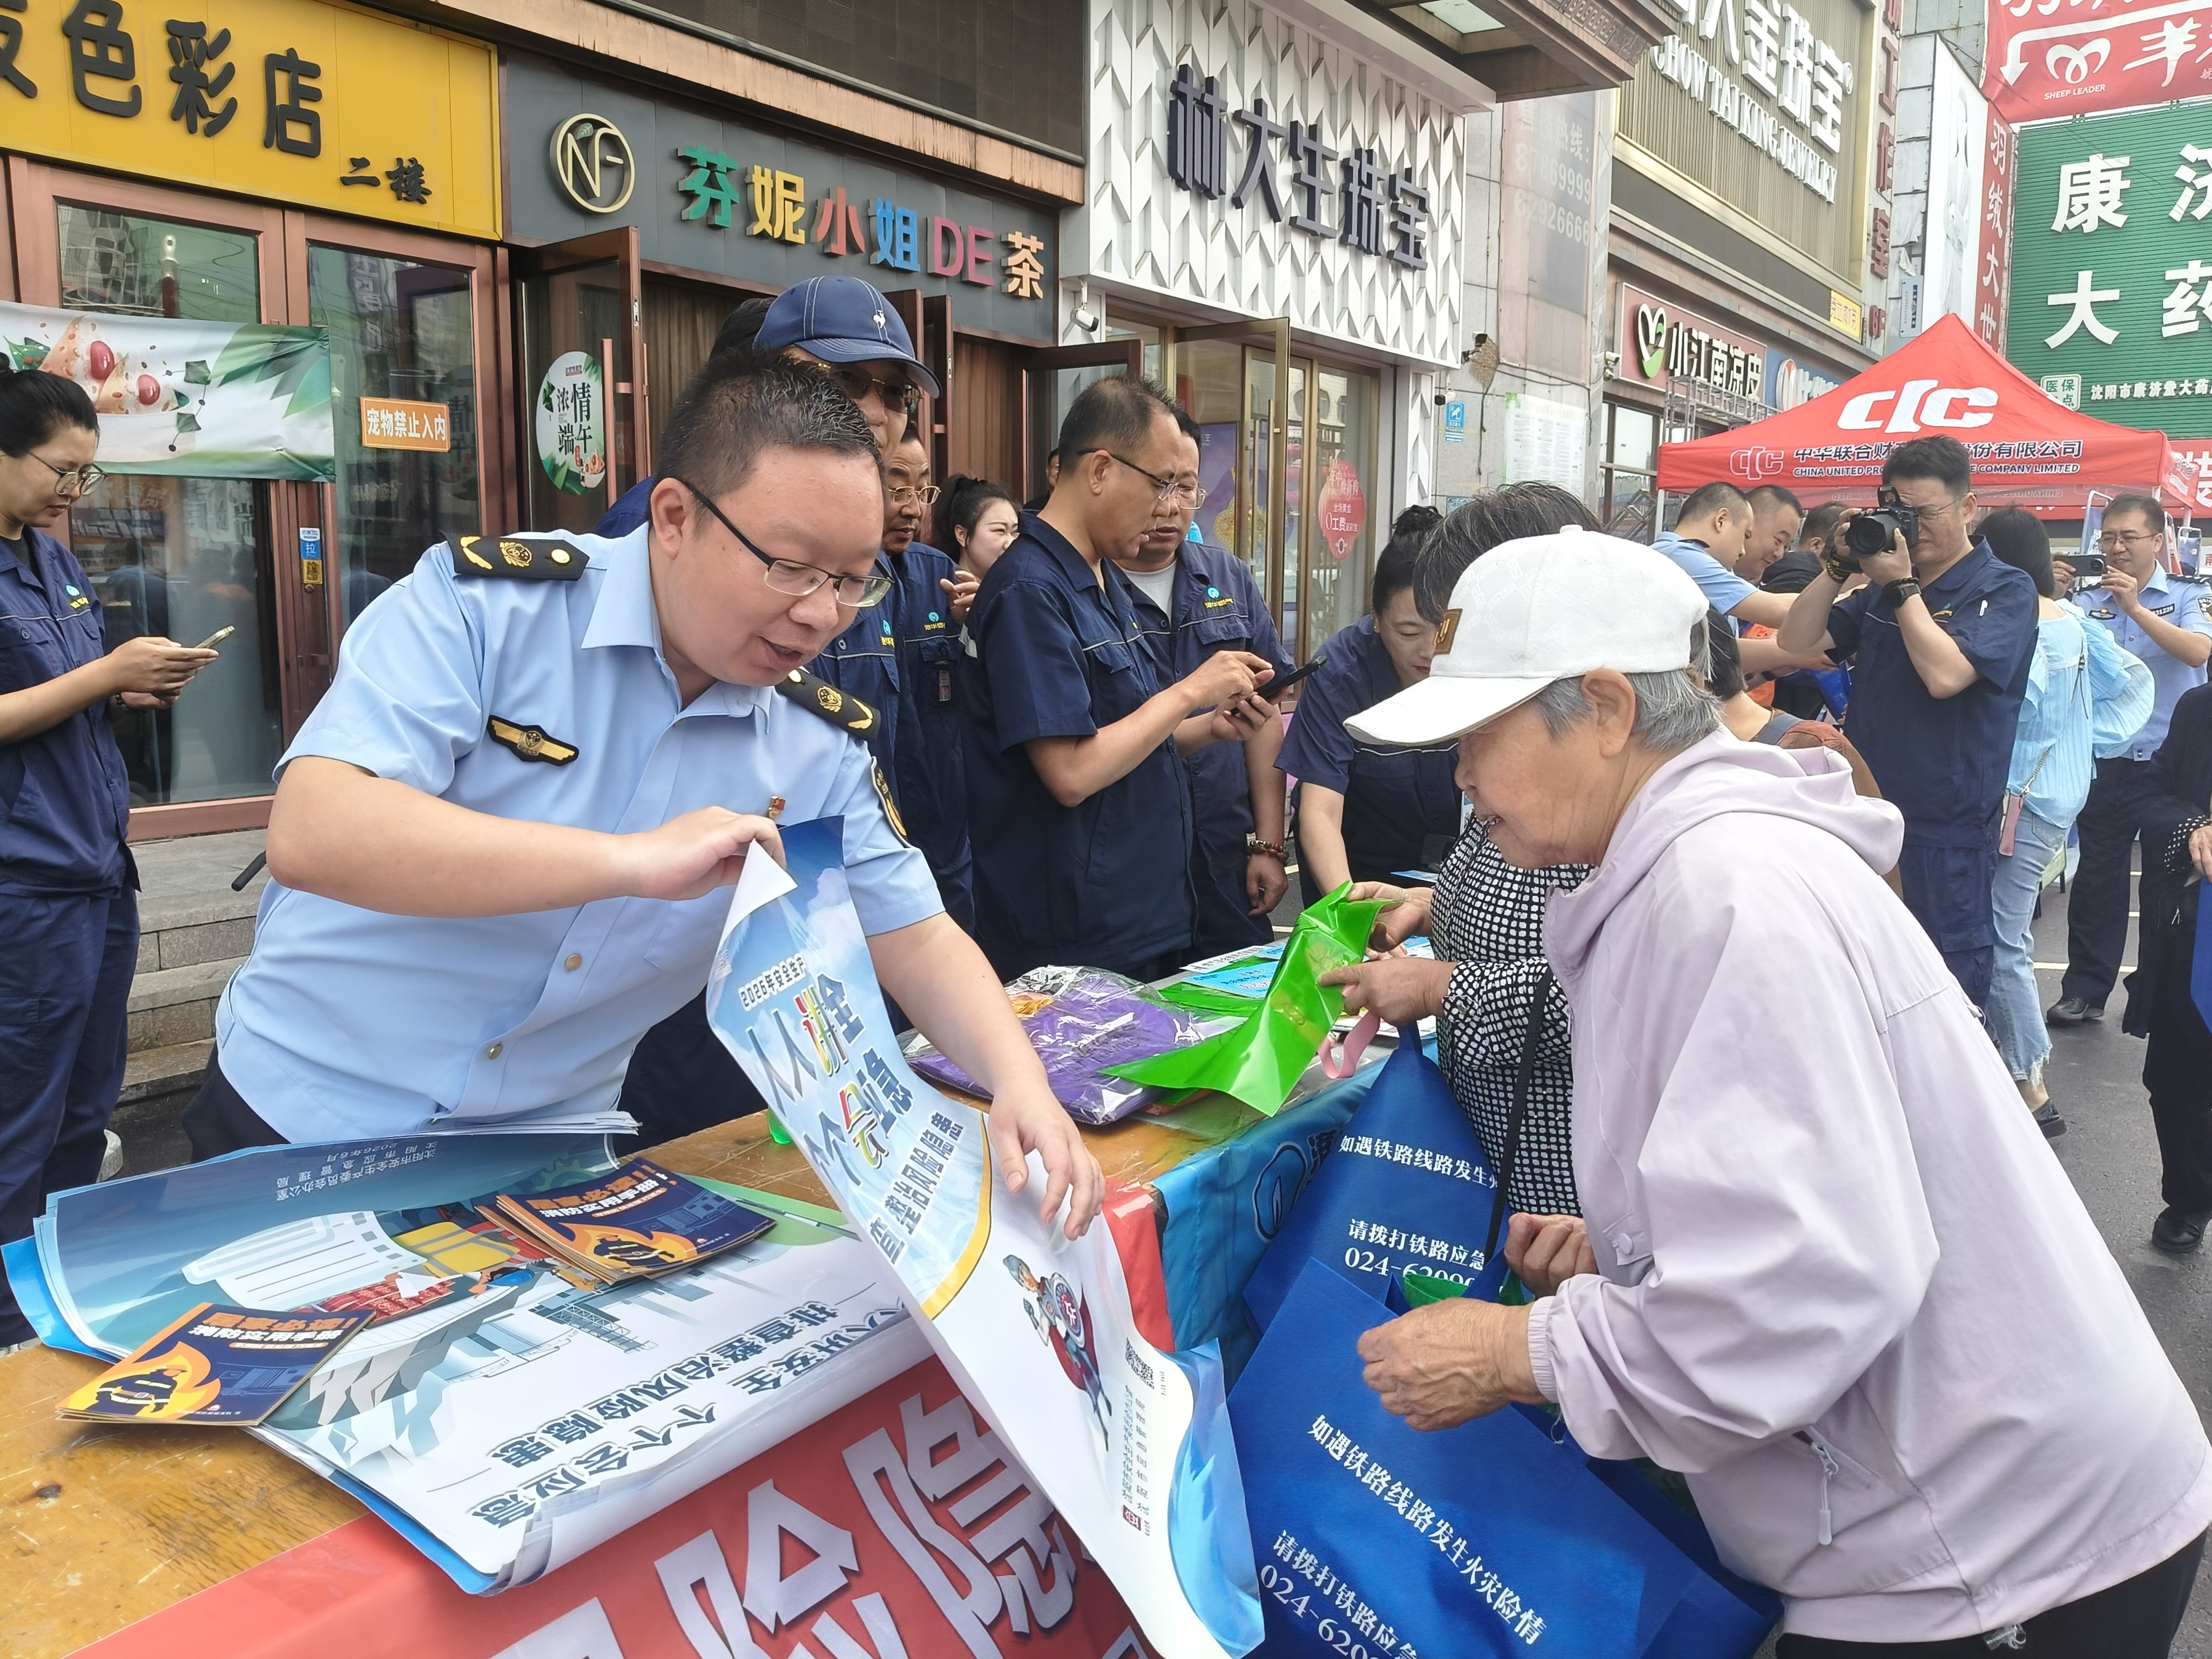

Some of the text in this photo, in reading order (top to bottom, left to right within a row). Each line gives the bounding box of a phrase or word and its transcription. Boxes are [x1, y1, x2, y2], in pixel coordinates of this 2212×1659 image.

[2044, 84, 2106, 100] SHEEP LEADER
[1709, 66, 1740, 129] TAI
[1738, 92, 1778, 159] KING
[1777, 126, 1837, 204] JEWELRY
[340, 157, 432, 204] 二楼
[1169, 63, 1428, 271] 林大生珠宝
[677, 145, 1044, 300] 芬妮小姐DE茶
[2046, 379, 2074, 392] 医保
[2090, 379, 2212, 400] 沈阳市康济堂大药
[367, 409, 446, 441] 宠物禁止入内
[1793, 468, 1825, 476] CHINA
[1826, 467, 1865, 476] UNITED
[1979, 465, 2032, 474] COMPANY
[2033, 463, 2080, 473] LIMITED
[306, 542, 316, 554] 拉
[1348, 1218, 1485, 1271] 请拨打铁路应急
[188, 1325, 344, 1342] 消防实用手册
[492, 1301, 840, 1468] 排查整治风险隐患
[1308, 1413, 1548, 1645] 如遇铁路线路发生火灾险情
